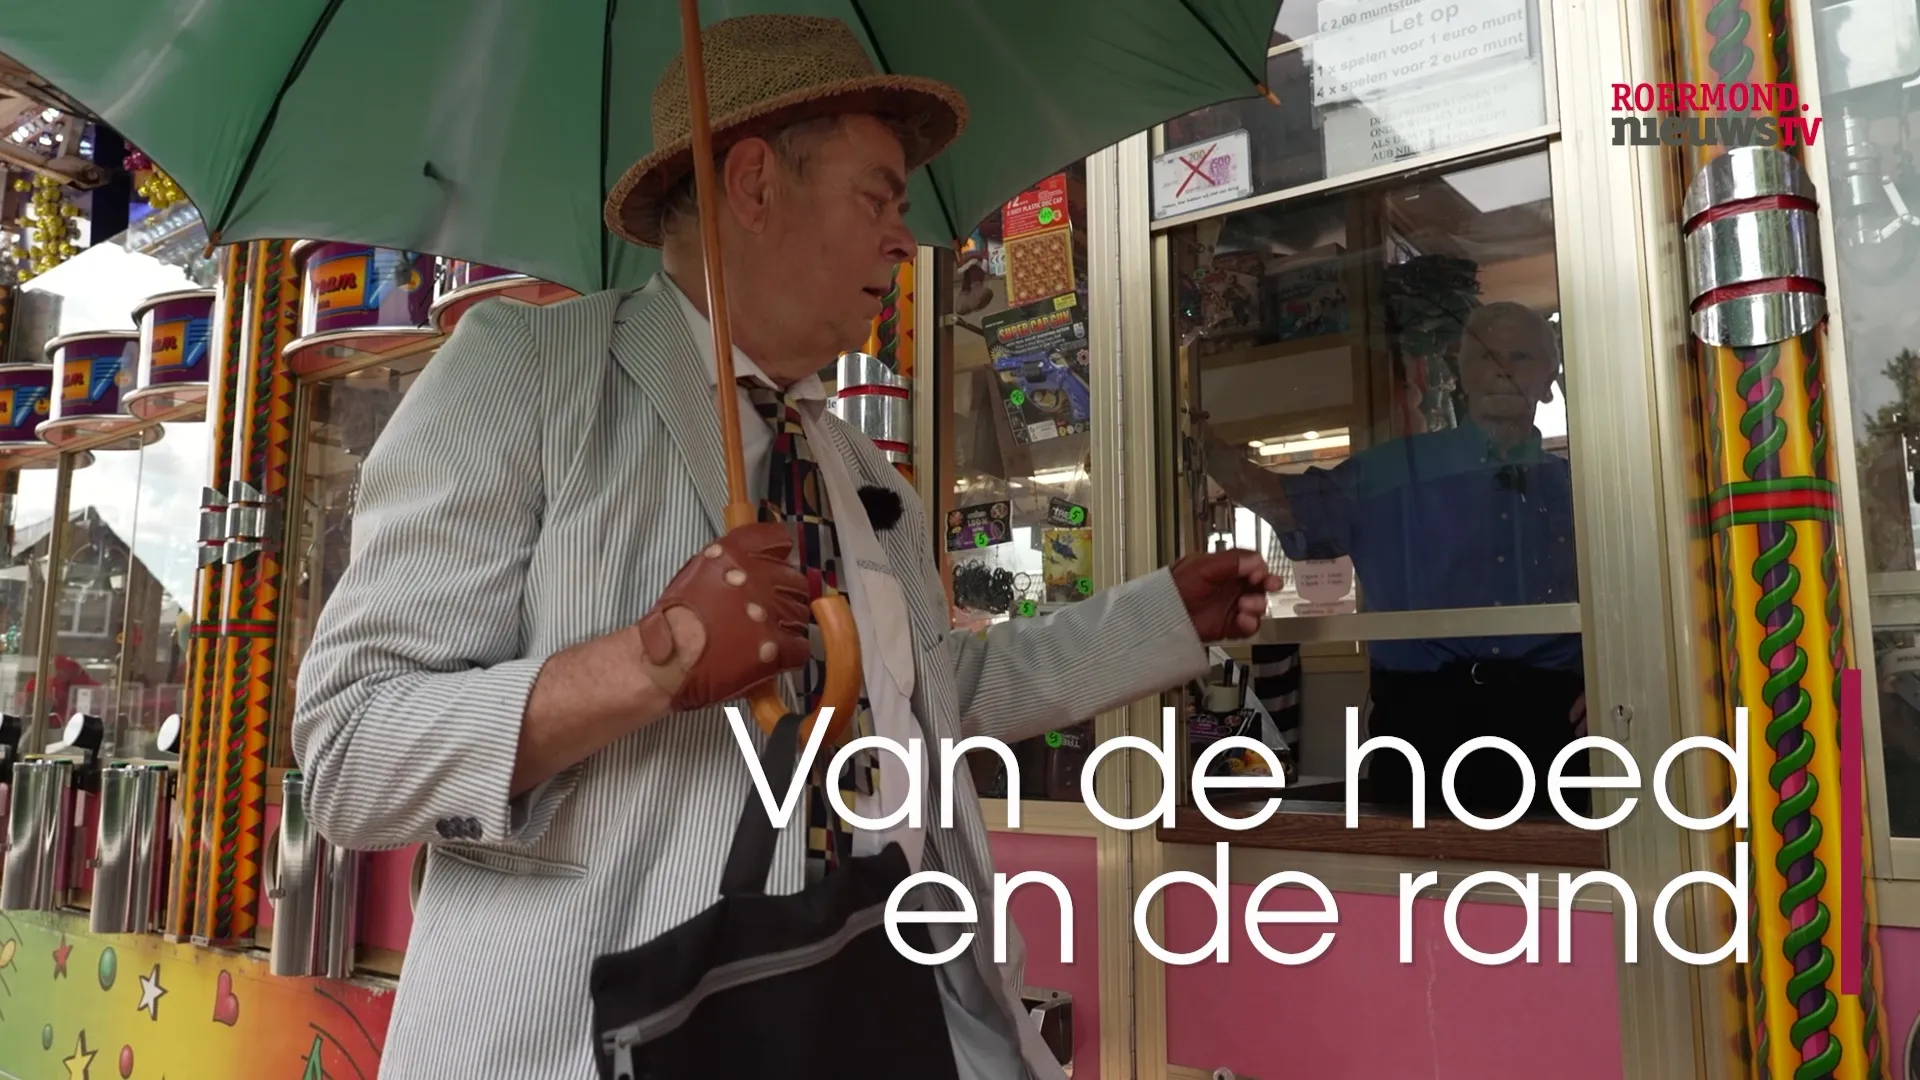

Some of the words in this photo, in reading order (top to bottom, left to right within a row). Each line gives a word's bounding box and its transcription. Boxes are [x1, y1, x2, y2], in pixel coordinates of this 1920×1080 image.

[1330, 13, 1357, 30] 2,00
[1390, 11, 1424, 34] Let
[1430, 4, 1459, 23] op
[1317, 65, 1323, 76] 1
[1328, 65, 1336, 75] x
[1341, 50, 1387, 72] spelen
[1391, 38, 1425, 55] voor
[1430, 32, 1436, 44] 1
[1443, 24, 1478, 42] euro
[1482, 9, 1524, 31] munt
[1317, 86, 1324, 98] 4
[1328, 86, 1336, 95] x
[1341, 71, 1388, 92] spelen
[1393, 60, 1426, 77] voor
[1430, 54, 1439, 67] 2
[1443, 46, 1478, 64] euro
[1483, 31, 1525, 53] munt
[1023, 201, 1042, 212] PLASTIC
[999, 321, 1030, 341] SUPER
[1030, 315, 1050, 333] CAP
[1050, 309, 1070, 328] GUN
[1072, 510, 1081, 520] 5
[1080, 579, 1089, 590] 5
